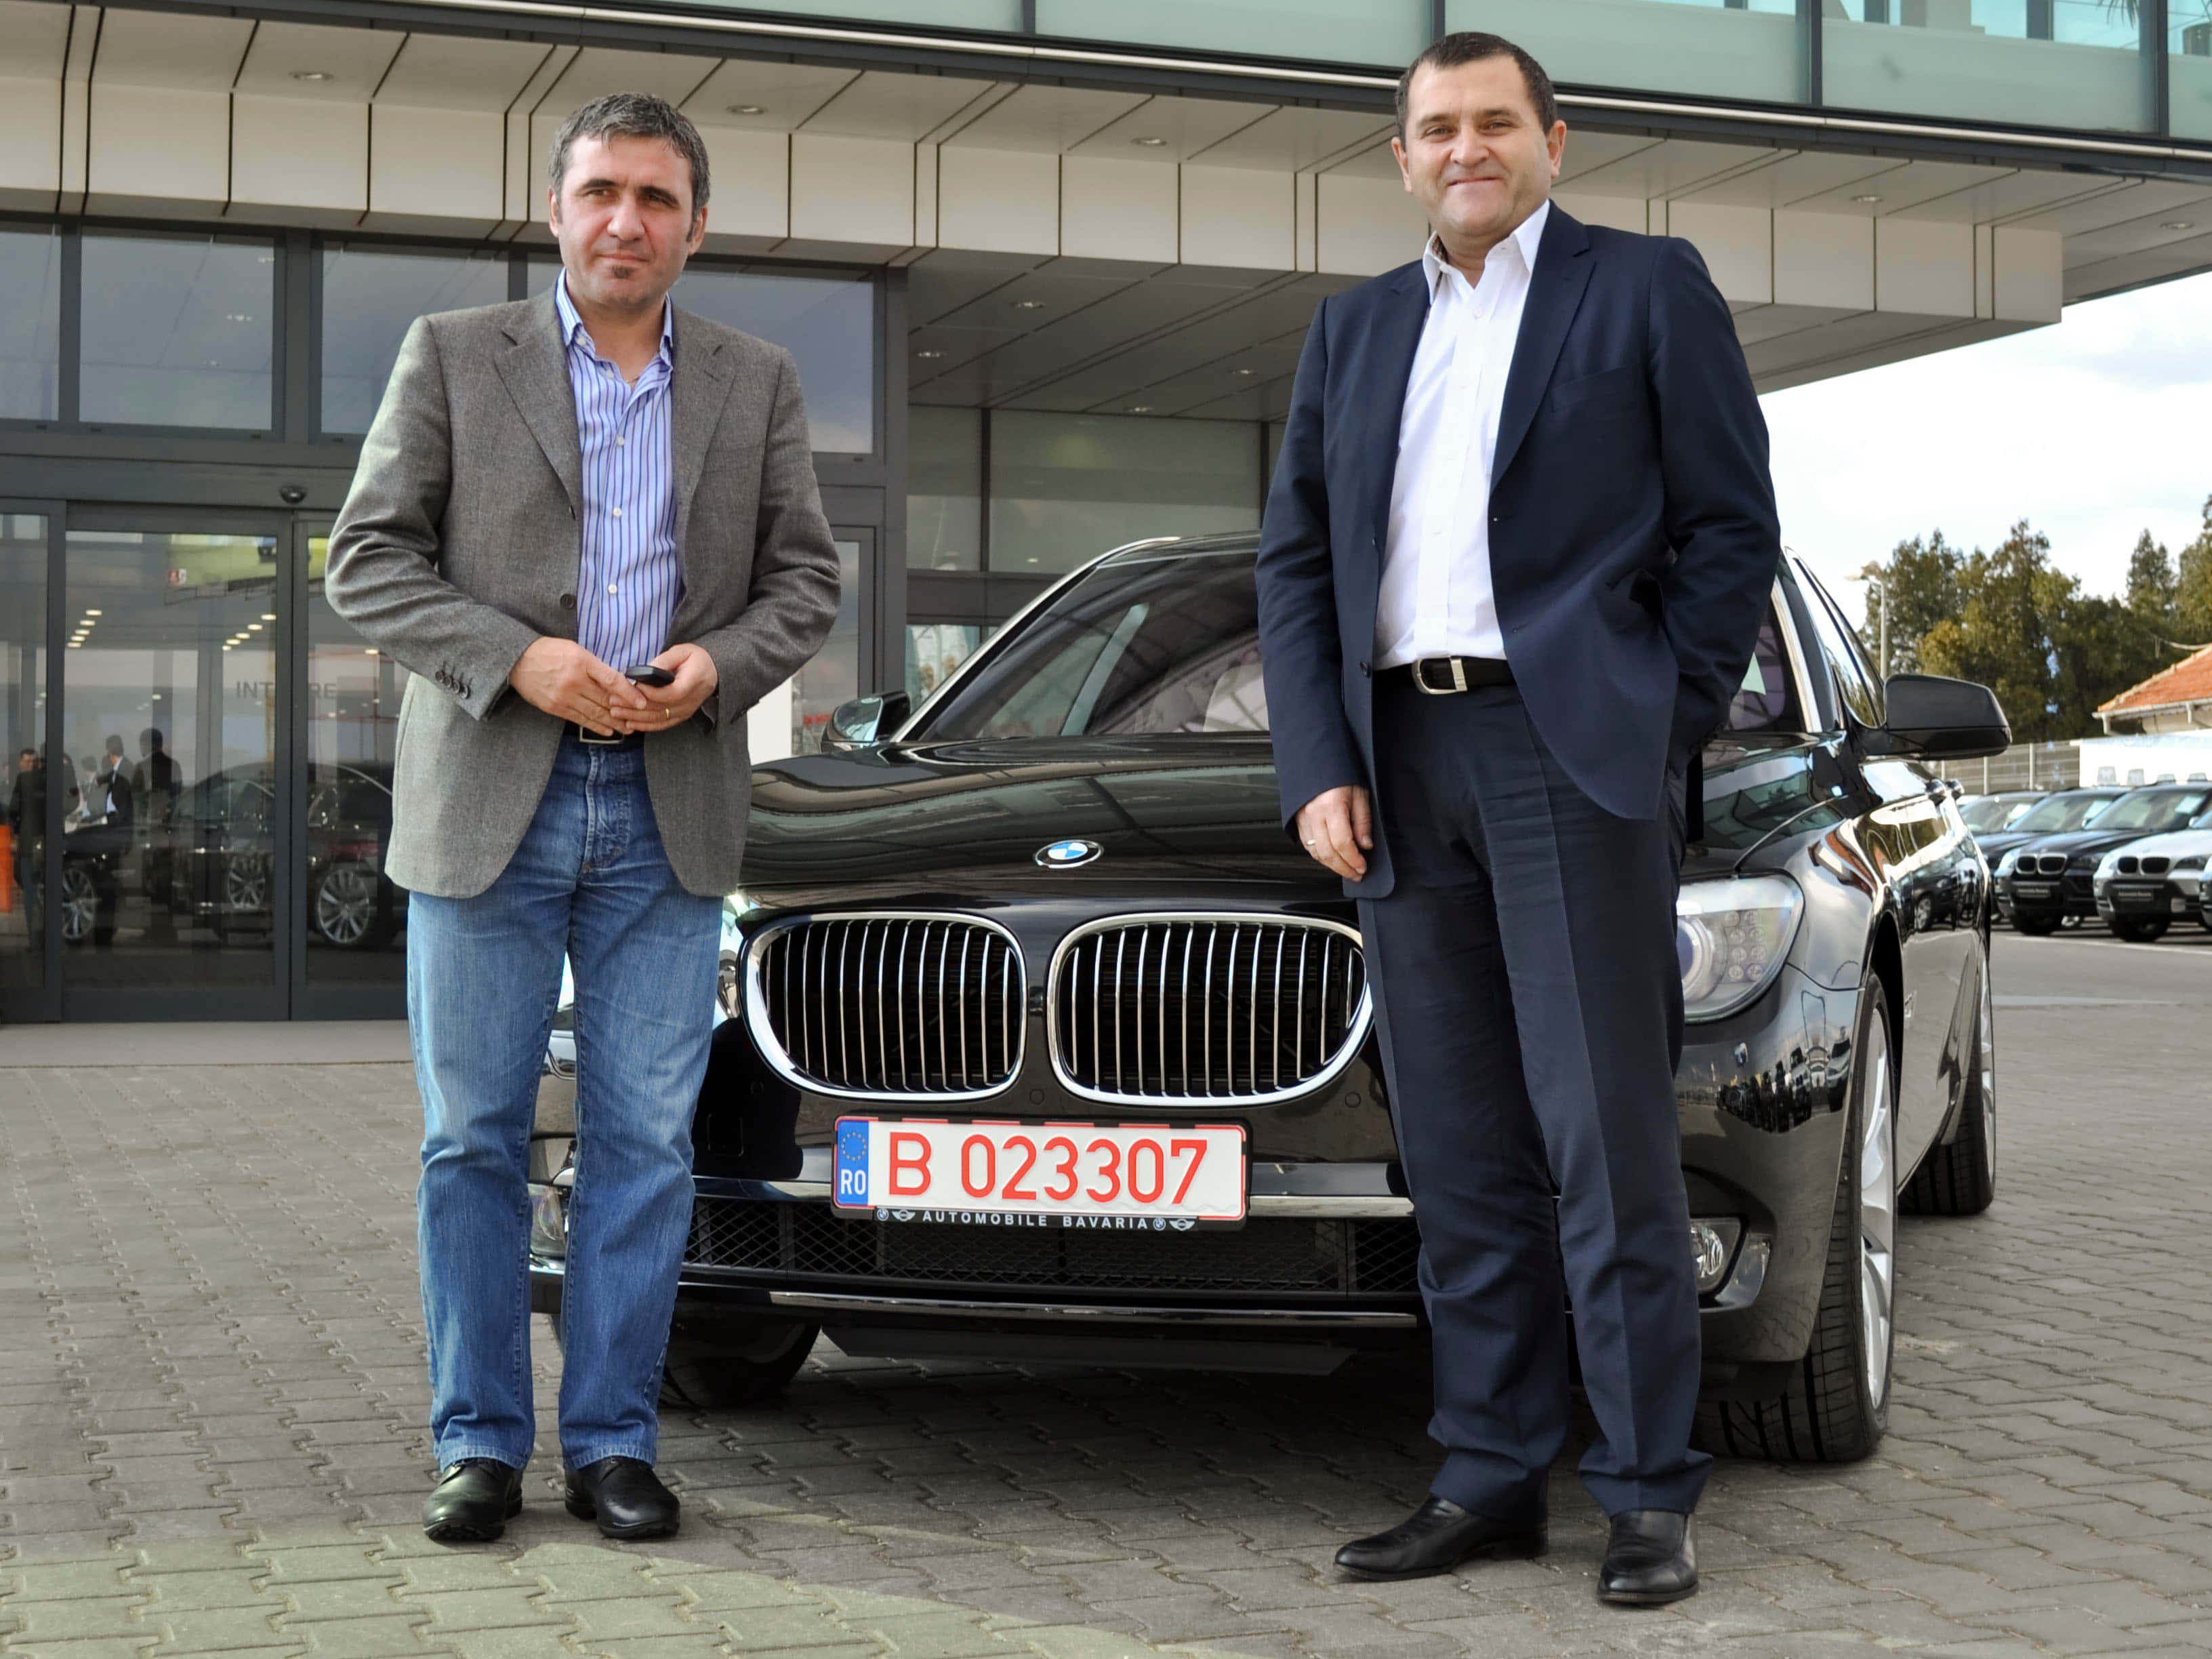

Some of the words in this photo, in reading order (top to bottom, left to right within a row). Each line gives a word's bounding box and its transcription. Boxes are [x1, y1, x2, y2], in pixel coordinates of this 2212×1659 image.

[237, 681, 337, 699] INTRE
[889, 1132, 931, 1195] B
[961, 1134, 1207, 1204] 023307
[841, 1169, 866, 1195] RO
[922, 1211, 1047, 1227] AUTOMOBILE
[1063, 1216, 1147, 1229] BAVARIA
